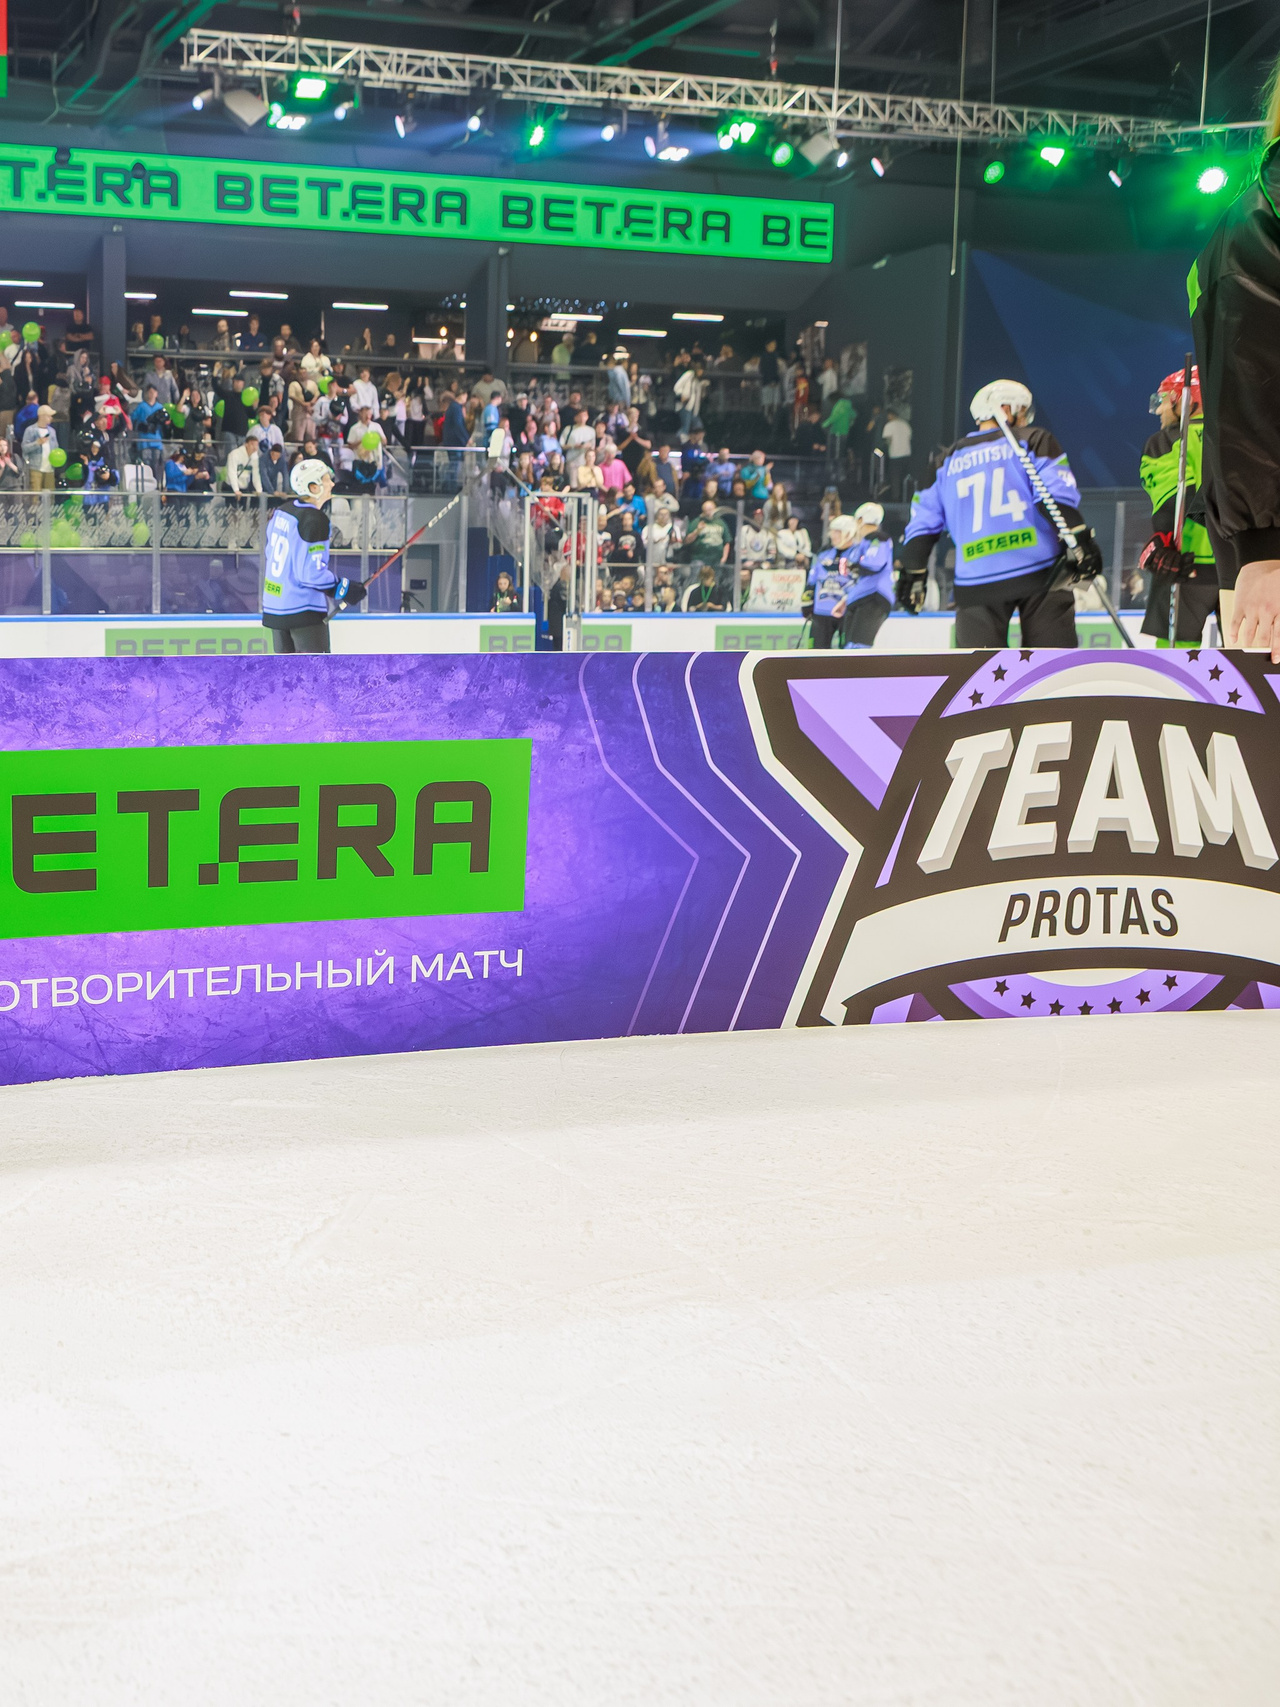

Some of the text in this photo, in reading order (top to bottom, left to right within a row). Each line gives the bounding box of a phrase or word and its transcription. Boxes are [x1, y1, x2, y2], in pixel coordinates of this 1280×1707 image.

[955, 466, 1028, 534] 74
[916, 719, 1280, 875] TEAM
[997, 886, 1179, 944] PROTAS
[411, 948, 524, 983] МАТЧ
